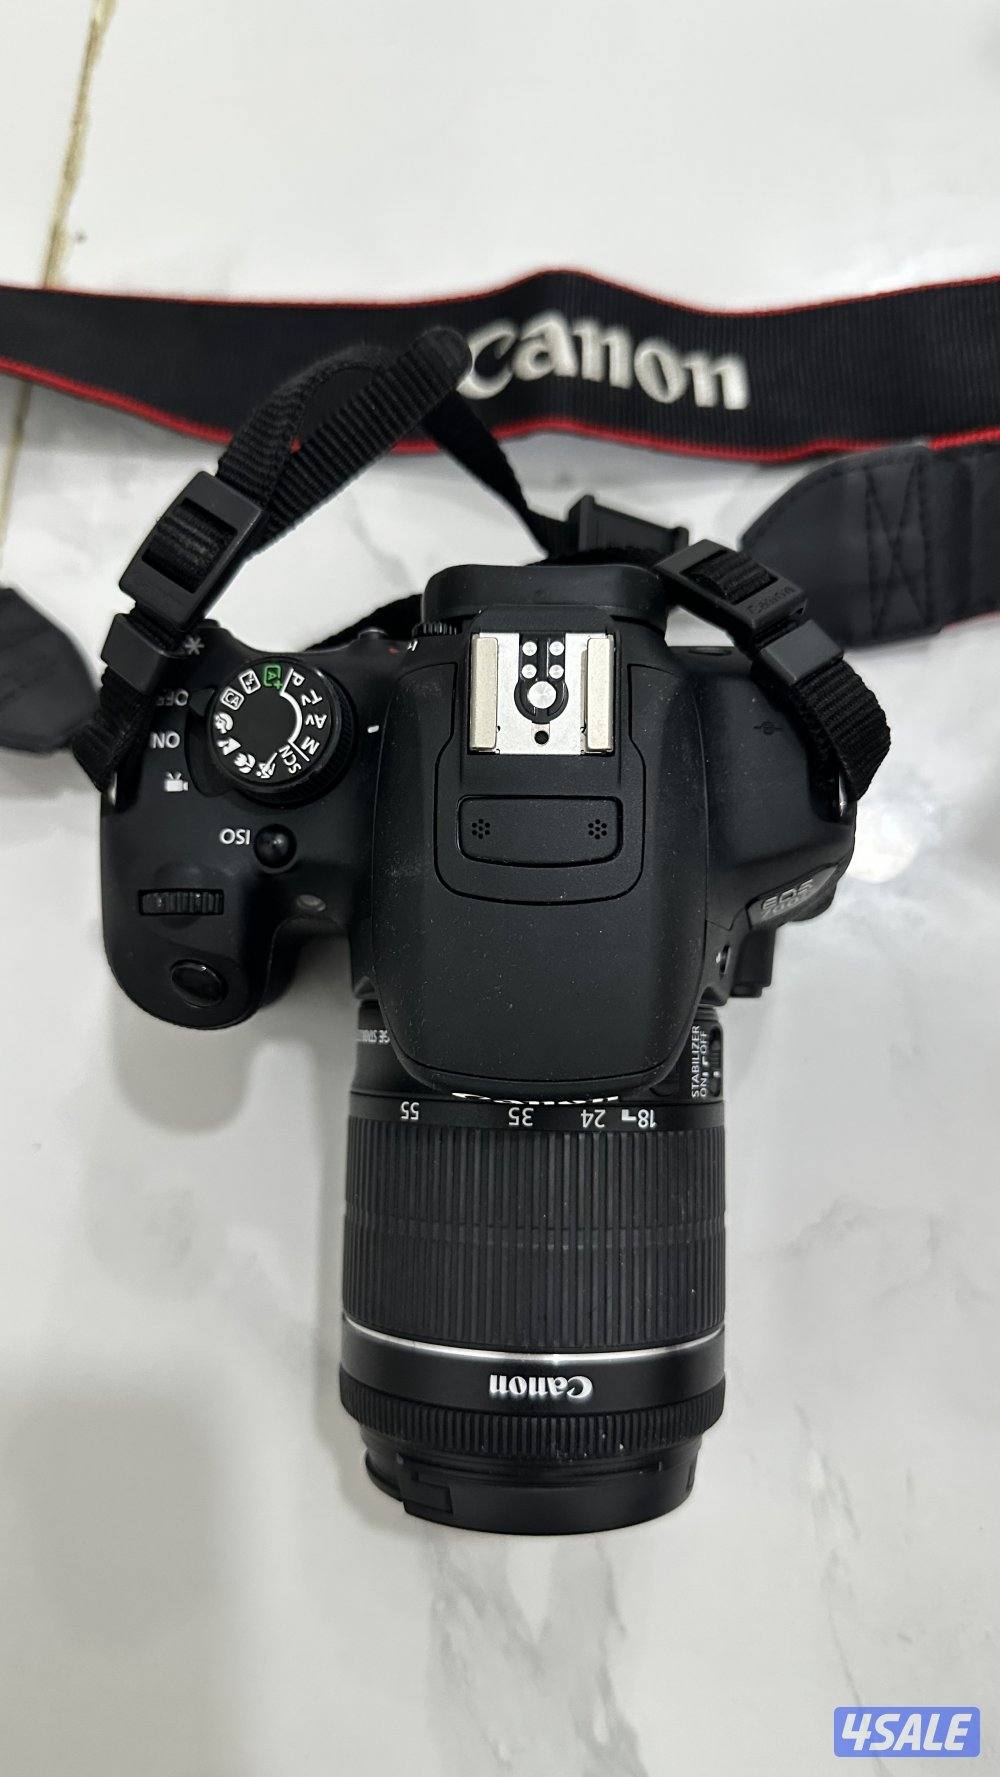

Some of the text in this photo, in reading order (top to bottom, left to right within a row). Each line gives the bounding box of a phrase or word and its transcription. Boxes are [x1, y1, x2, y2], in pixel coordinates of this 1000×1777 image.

[457, 309, 750, 410] Canon
[292, 672, 305, 687] P
[301, 689, 323, 706] Tv
[305, 714, 328, 729] Av
[152, 731, 181, 749] ON
[301, 736, 321, 756] M
[280, 745, 302, 774] SCN
[219, 828, 250, 846] ISO
[691, 1025, 701, 1098] STABILIZER
[700, 1031, 708, 1097] ON OFF
[400, 1101, 420, 1120] 55
[508, 1107, 534, 1127] 35
[581, 1109, 606, 1128] 24
[637, 1109, 657, 1128] 18
[489, 1373, 593, 1399] Canon
